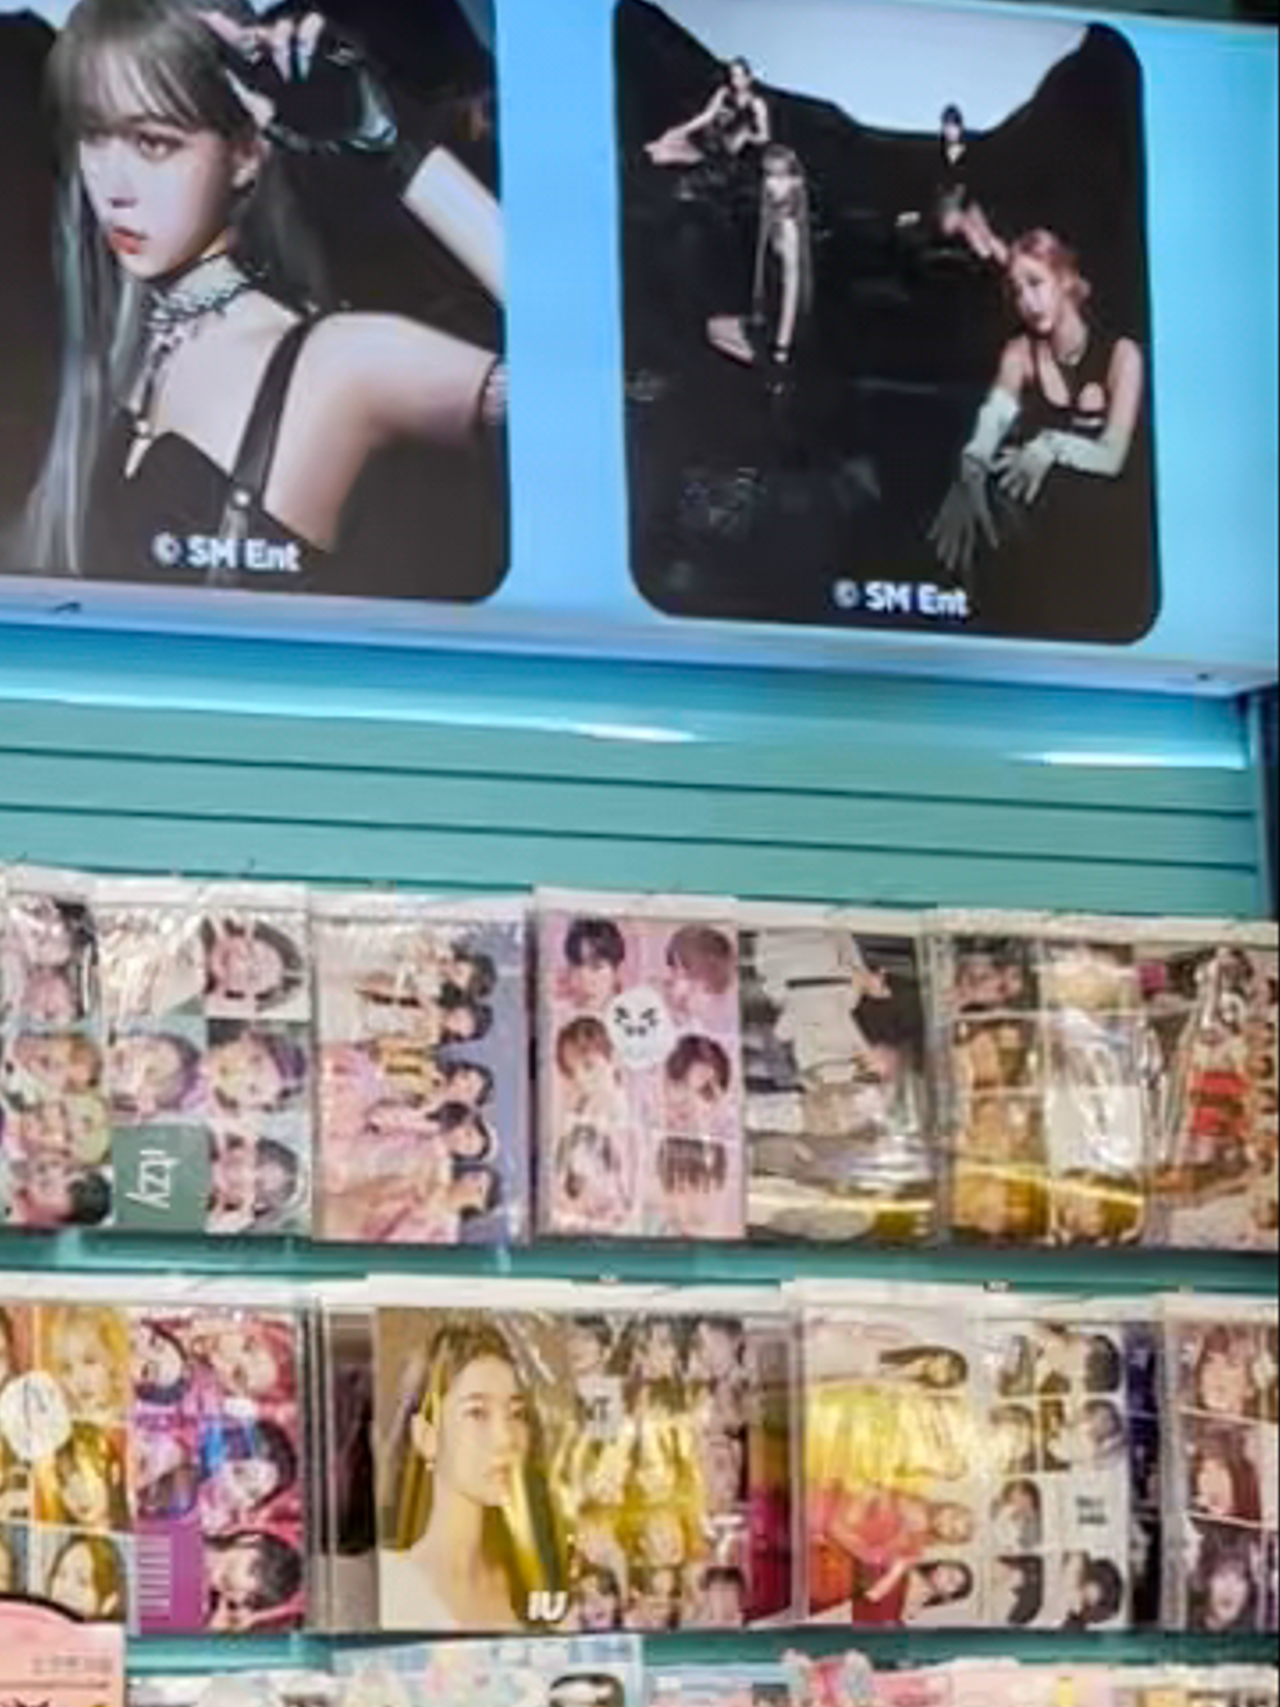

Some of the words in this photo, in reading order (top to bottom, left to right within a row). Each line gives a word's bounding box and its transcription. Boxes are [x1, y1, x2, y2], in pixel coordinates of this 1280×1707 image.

[187, 535, 238, 568] SM
[246, 539, 301, 572] Ent
[865, 581, 911, 611] SM
[918, 584, 970, 618] Ent
[528, 1591, 568, 1622] IU
